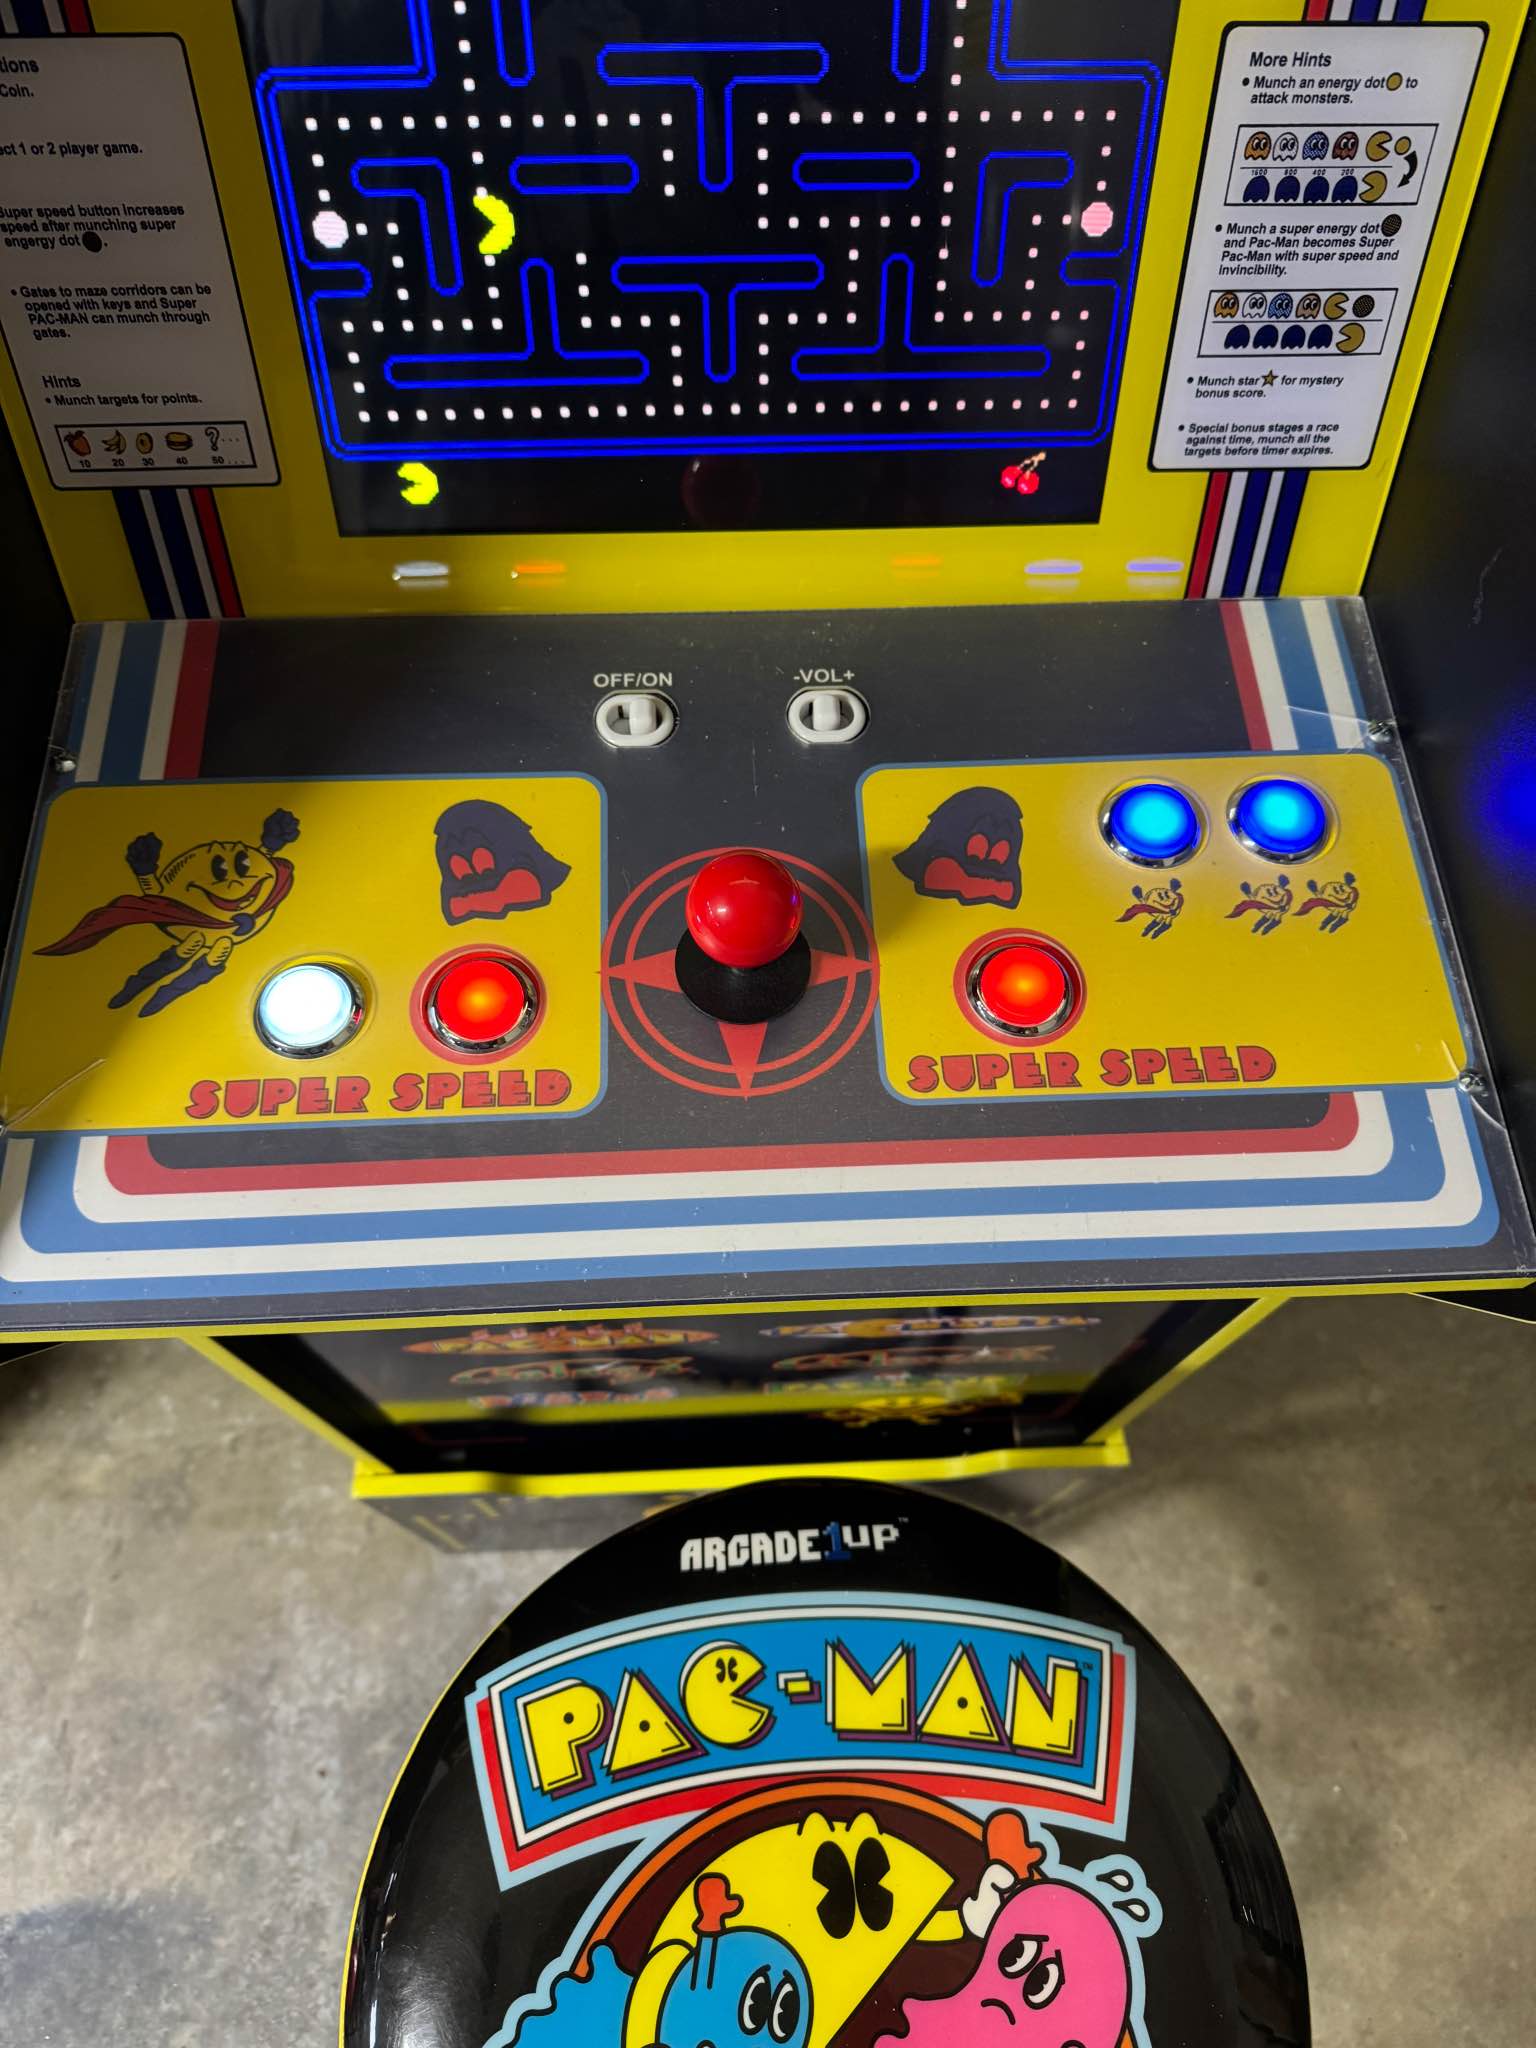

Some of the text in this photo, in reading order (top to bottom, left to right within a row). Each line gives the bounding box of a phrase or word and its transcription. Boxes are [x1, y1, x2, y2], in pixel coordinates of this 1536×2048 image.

[1250, 52, 1332, 67] More Hints
[1254, 76, 1418, 91] Munch an energy dot to
[1250, 92, 1353, 104] attack monsters.
[19, 142, 26, 155] 1
[31, 145, 44, 155] or
[47, 142, 56, 154] 2
[60, 142, 100, 157] player
[103, 143, 143, 157] game.
[37, 204, 75, 219] speed
[80, 204, 120, 218] button
[124, 203, 184, 216] increases
[42, 219, 70, 232] after
[74, 218, 137, 232] munching
[140, 219, 176, 232] super
[1226, 222, 1380, 237] Munch a super energy dot
[1224, 236, 1395, 250] and Pac-Man becomes Super
[1221, 249, 1399, 264] Pac-Man with super speed and
[20, 284, 212, 298] Gates to maze corridors can be
[25, 298, 197, 313] opened with keys and Super
[28, 311, 210, 325] PAC-MAN can munch through
[33, 327, 71, 340] gates.
[42, 375, 81, 388] Hints
[1197, 375, 1344, 388] Munch star for mystery
[54, 393, 202, 407] Munch targets for points.
[1195, 388, 1267, 398] bonus score.
[1188, 422, 1340, 435] Special bonus stages a race
[1186, 434, 1330, 447] against time, munch all the
[1184, 445, 1334, 459] targets before timer expires.
[79, 459, 91, 468] 10
[112, 458, 125, 467] 20
[593, 672, 673, 688] OFF/ON
[907, 1045, 1277, 1093] SUPER SPEED
[185, 1069, 572, 1120] SUPER SPEED
[515, 1635, 1089, 1800] PAC-MAN
